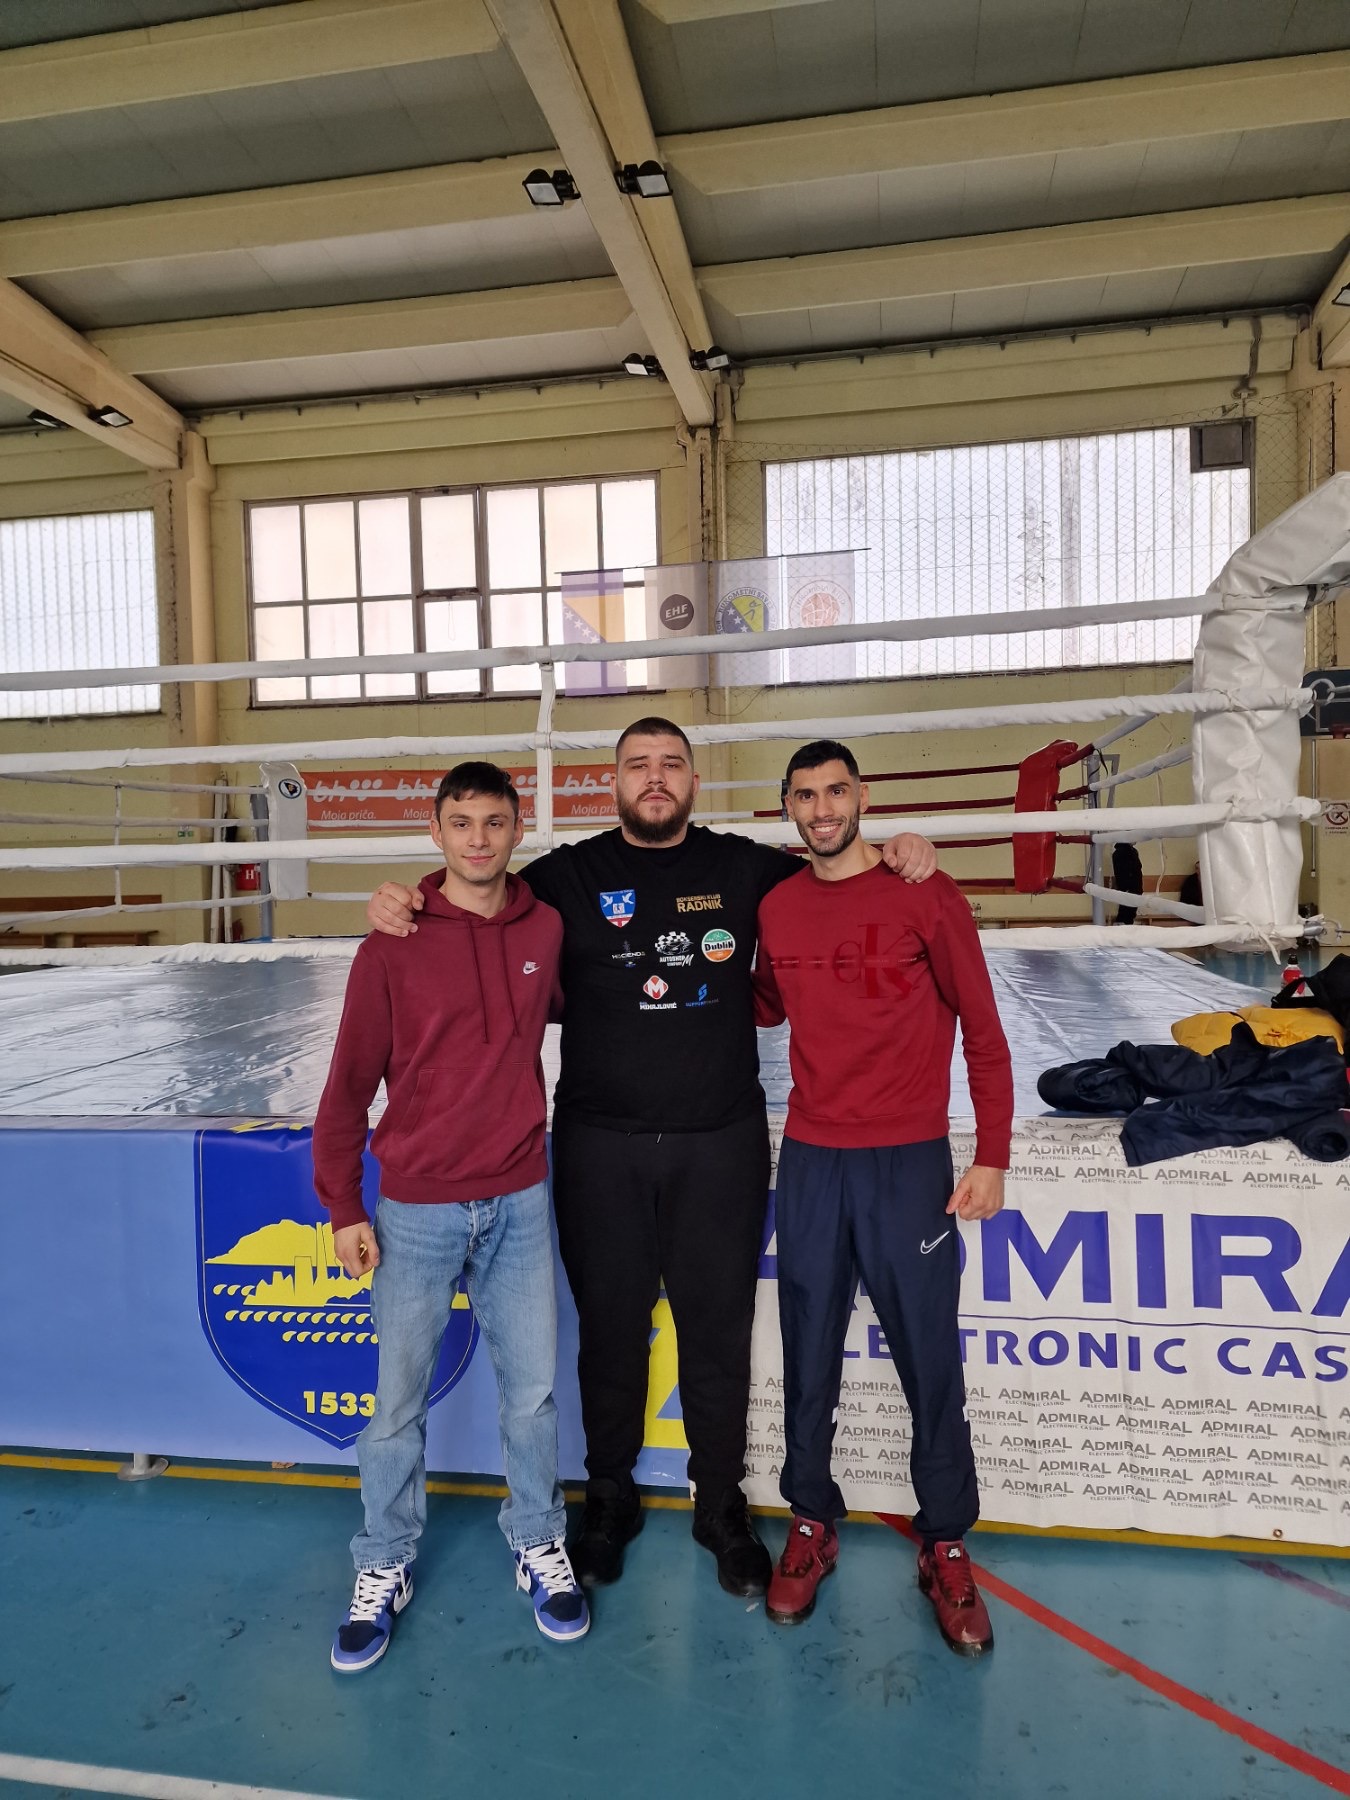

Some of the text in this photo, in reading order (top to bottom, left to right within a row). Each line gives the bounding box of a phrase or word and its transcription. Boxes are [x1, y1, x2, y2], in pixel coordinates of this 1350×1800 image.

[665, 604, 688, 618] EHF
[321, 810, 347, 820] Moja
[403, 808, 429, 820] Moja
[571, 804, 599, 816] Moja
[245, 869, 254, 880] H
[677, 899, 723, 912] RADNIK
[1027, 1143, 1101, 1156] ADMIRAL
[1193, 1148, 1272, 1160] ADMIRAL
[1005, 1165, 1065, 1178] DMIRAL
[1074, 1166, 1149, 1180] ADMIRAL
[1154, 1168, 1233, 1182] ADMIRAL
[1242, 1171, 1323, 1185] ADMIRAL
[998, 1387, 1071, 1401] ADMIRAL
[1080, 1391, 1155, 1408] ADMIRAL
[303, 1391, 377, 1417] 1533
[1161, 1398, 1238, 1411] ADMIRAL
[1246, 1400, 1328, 1419] ADMIRAL
[967, 1409, 1028, 1423] DMIRAL
[1037, 1413, 1110, 1426] ADMIRAL
[1116, 1414, 1192, 1433] ADMIRAL
[1201, 1420, 1278, 1436] ADMIRAL
[841, 1425, 913, 1440] ADMIRAL
[1000, 1435, 1072, 1449] ADMIRAL
[1081, 1439, 1156, 1455] ADMIRAL
[1162, 1445, 1238, 1459] ADMIRAL
[1246, 1448, 1329, 1467] ADMIRAL
[974, 1456, 1030, 1470] DMIRAL
[1038, 1460, 1112, 1474] ADMIRAL
[842, 1467, 913, 1483] ADMIRAL
[1117, 1462, 1194, 1481] ADMIRAL
[1202, 1469, 1279, 1484] ADMIRAL
[1001, 1479, 1074, 1493] ADMIRAL
[1082, 1483, 1157, 1500] ADMIRAL
[1163, 1489, 1238, 1503] ADMIRAL
[1247, 1492, 1329, 1511] ADMIRAL
